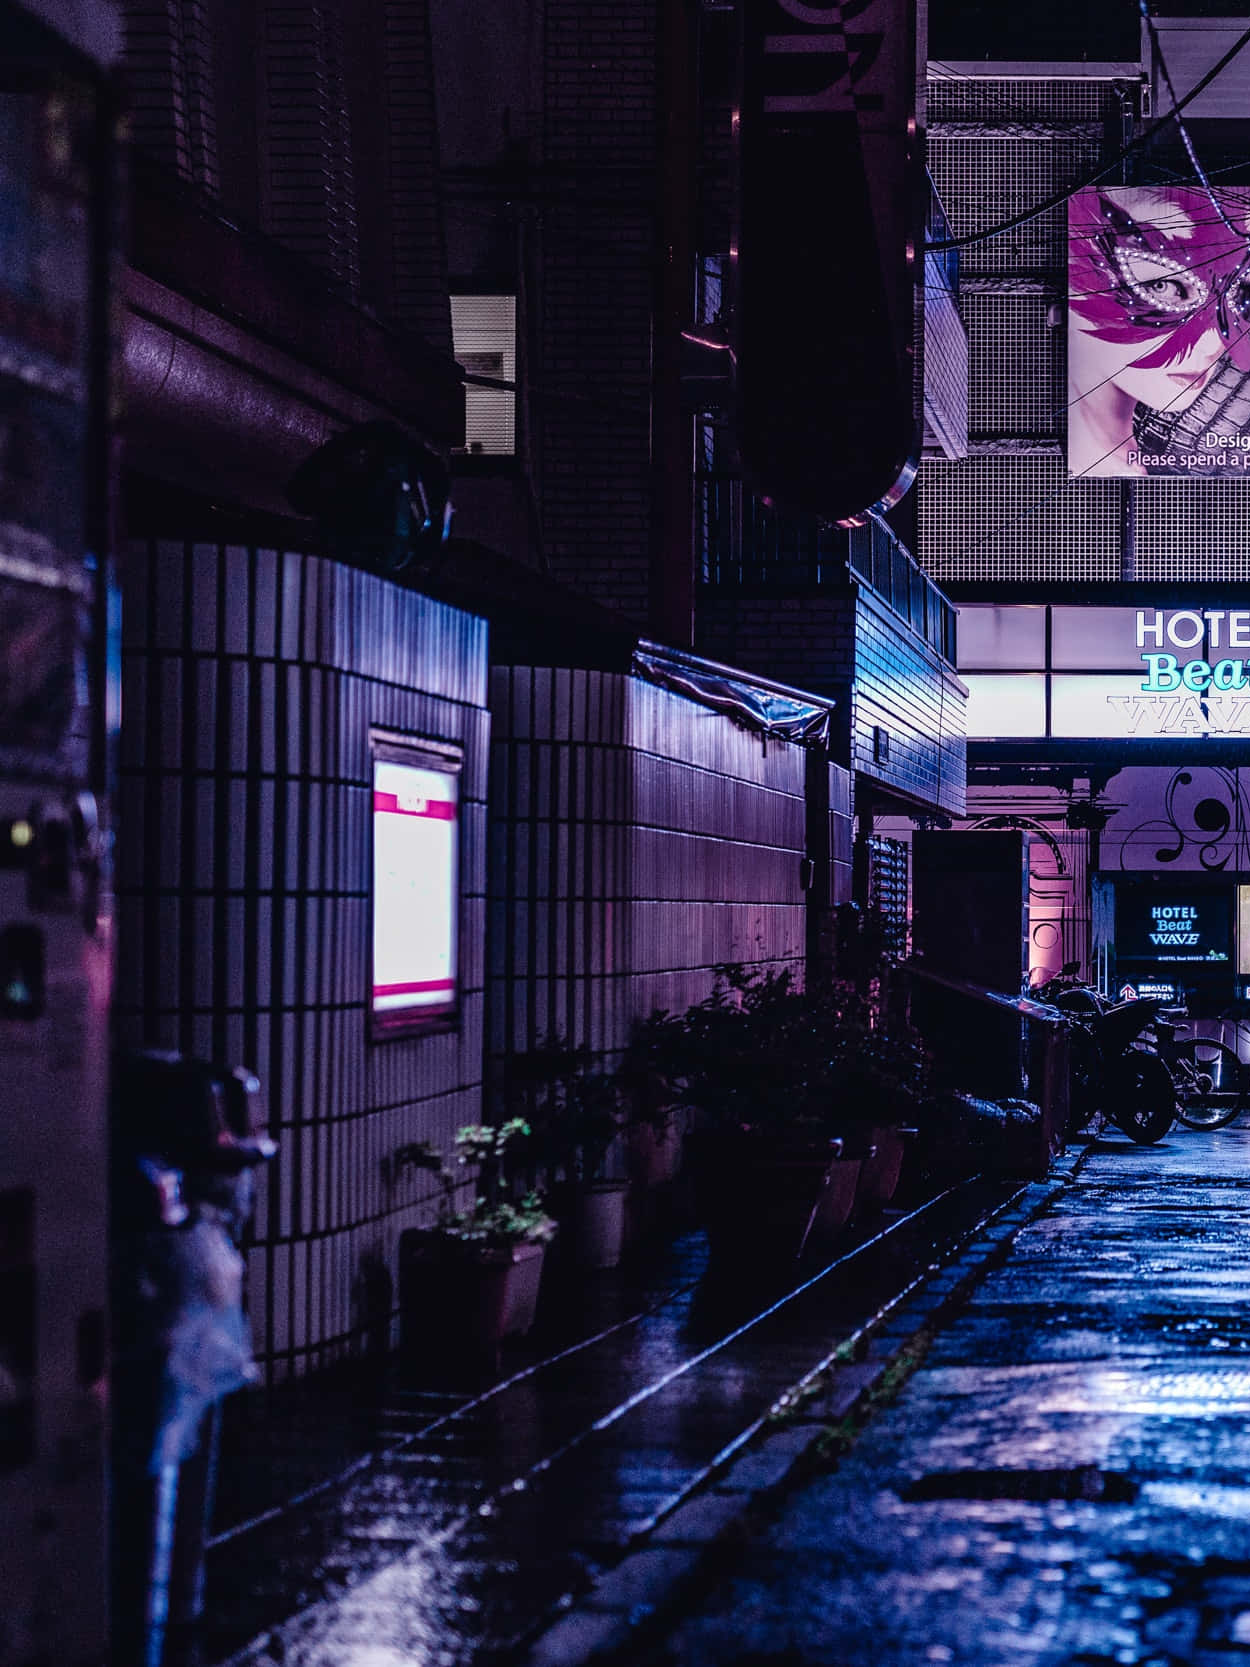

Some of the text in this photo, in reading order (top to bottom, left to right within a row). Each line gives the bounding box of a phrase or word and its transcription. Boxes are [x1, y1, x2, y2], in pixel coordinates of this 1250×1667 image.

[1128, 451, 1175, 466] Please
[1180, 451, 1227, 469] spend
[1231, 455, 1238, 466] a
[1151, 907, 1198, 919] HOTEL
[1156, 919, 1193, 932] Beat
[1149, 933, 1200, 945] WAVE
